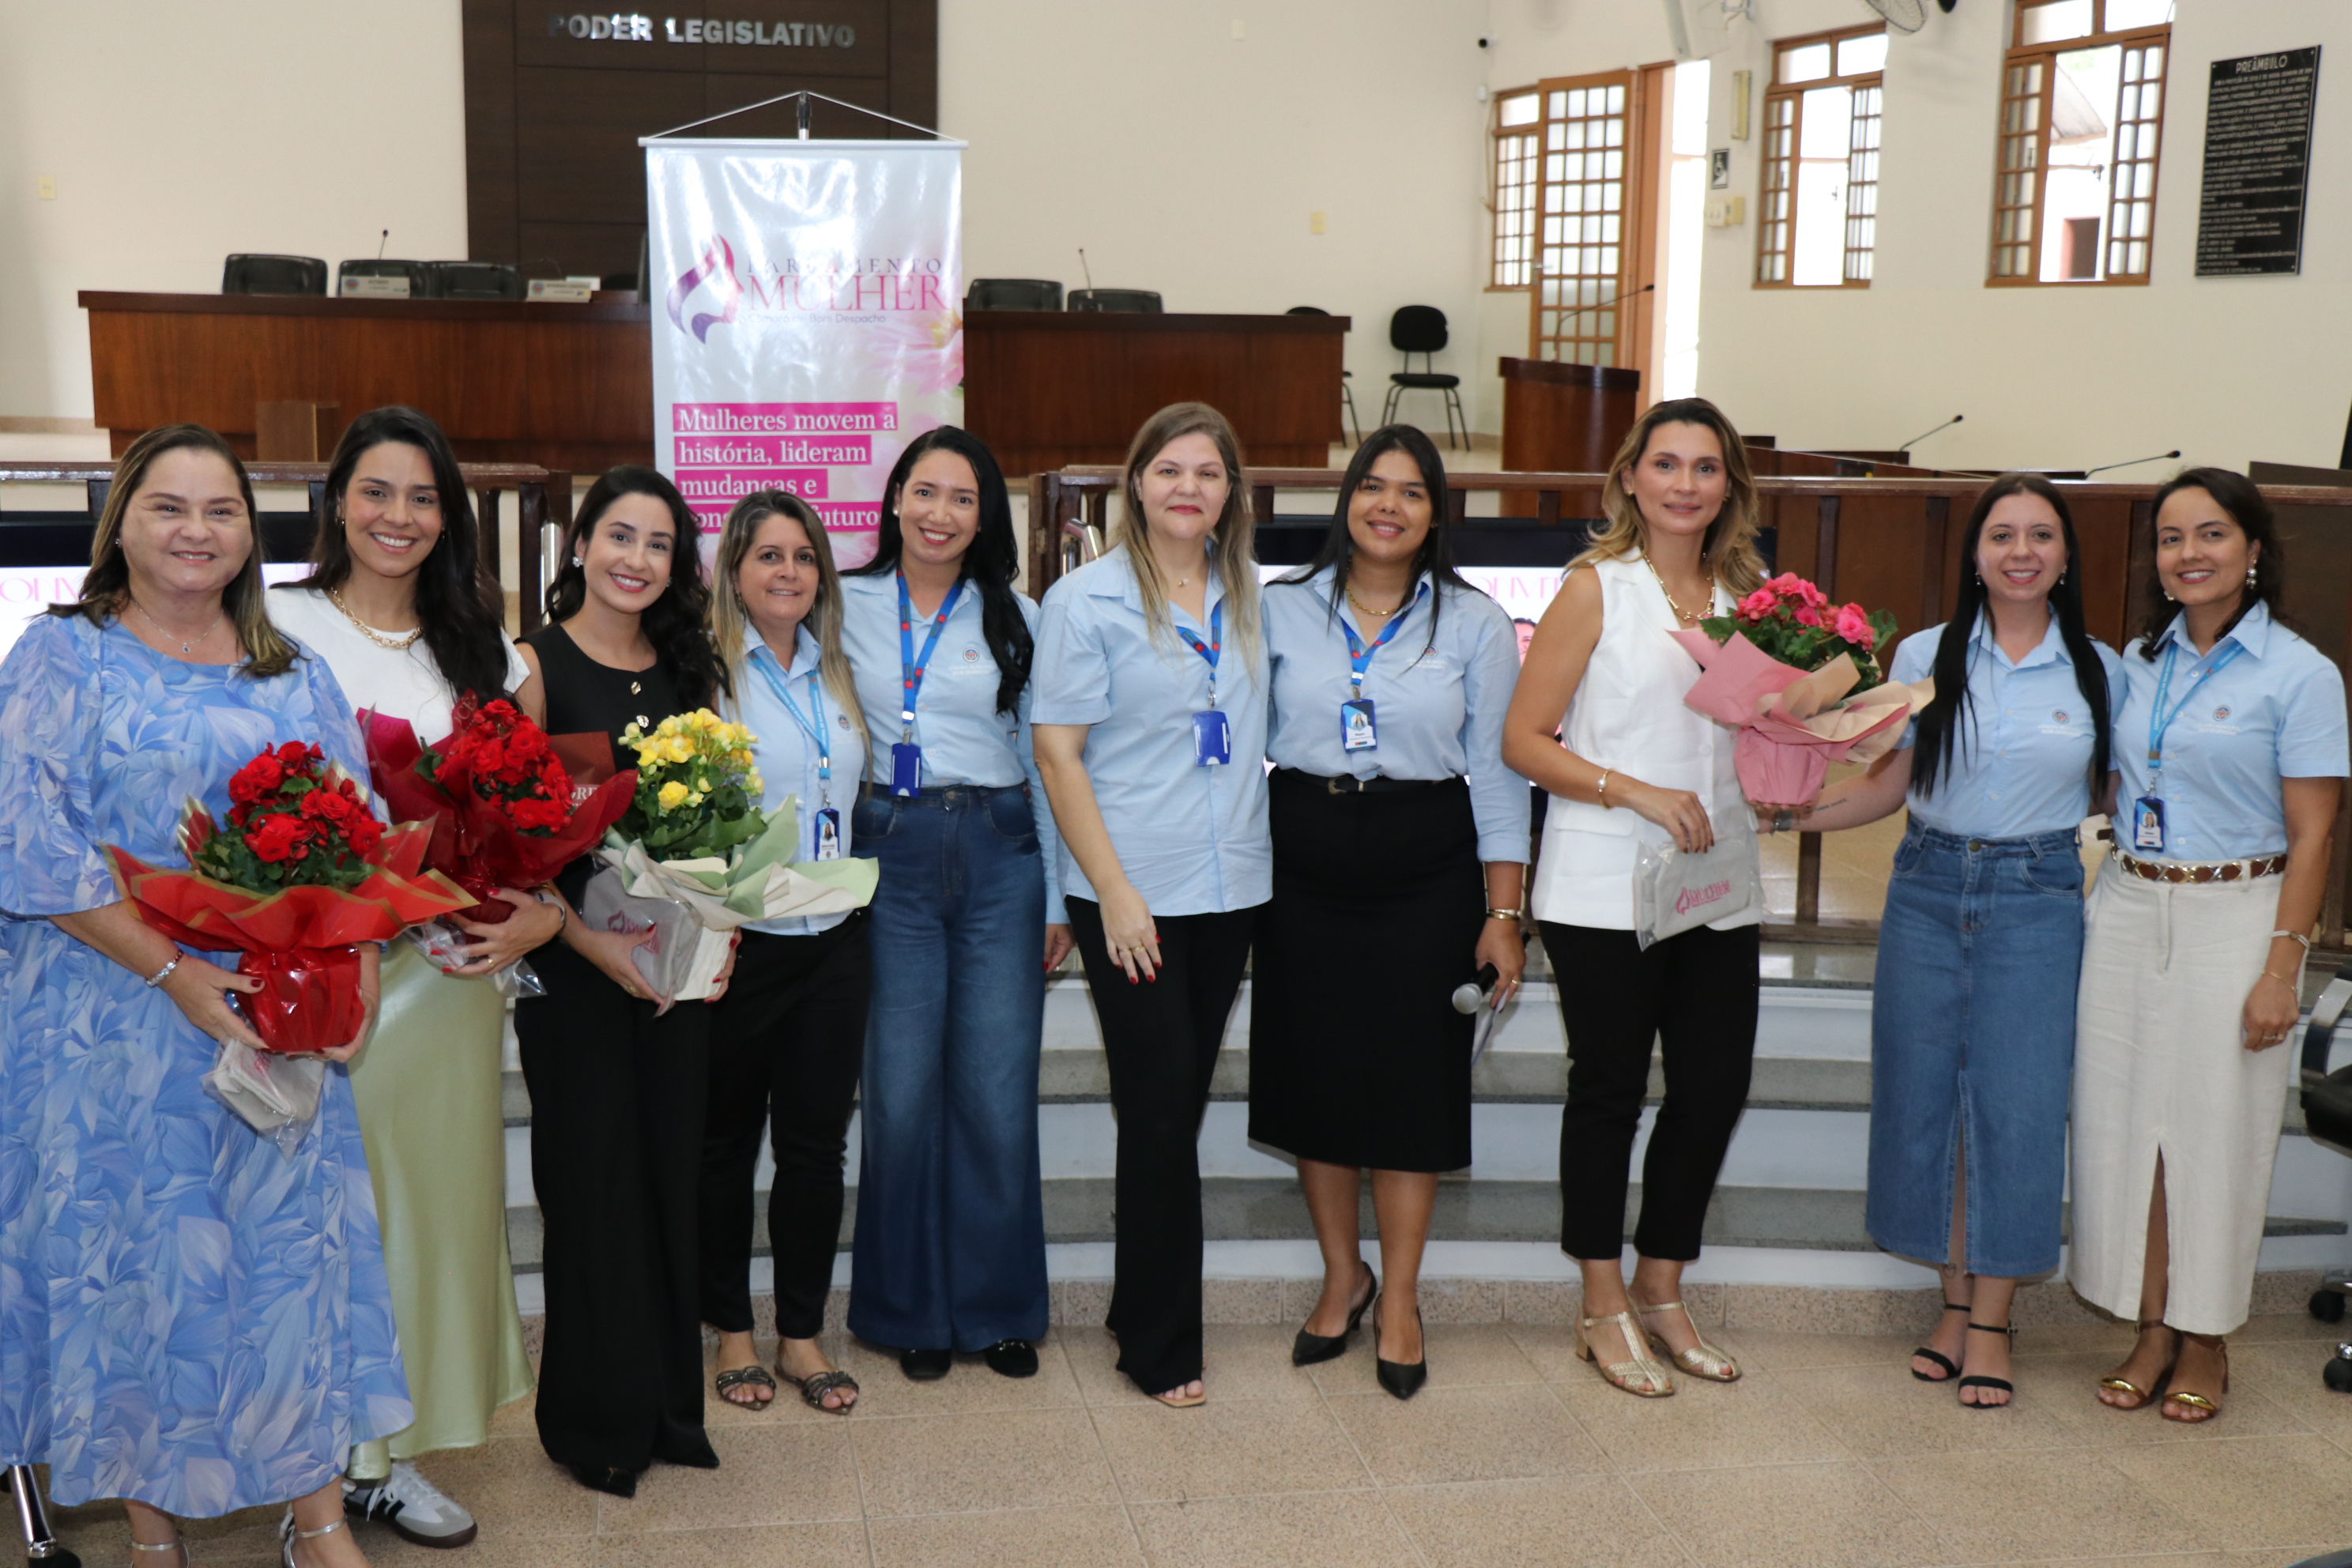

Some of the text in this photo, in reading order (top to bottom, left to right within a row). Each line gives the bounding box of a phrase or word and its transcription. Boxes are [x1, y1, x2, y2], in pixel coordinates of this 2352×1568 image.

[549, 13, 855, 48] PODER LEGISLATIVO
[747, 275, 950, 311] MULHER
[835, 314, 886, 324] Despacho
[679, 409, 895, 432] Mulheres movem a
[679, 440, 867, 466] história, lideram
[804, 478, 817, 495] e
